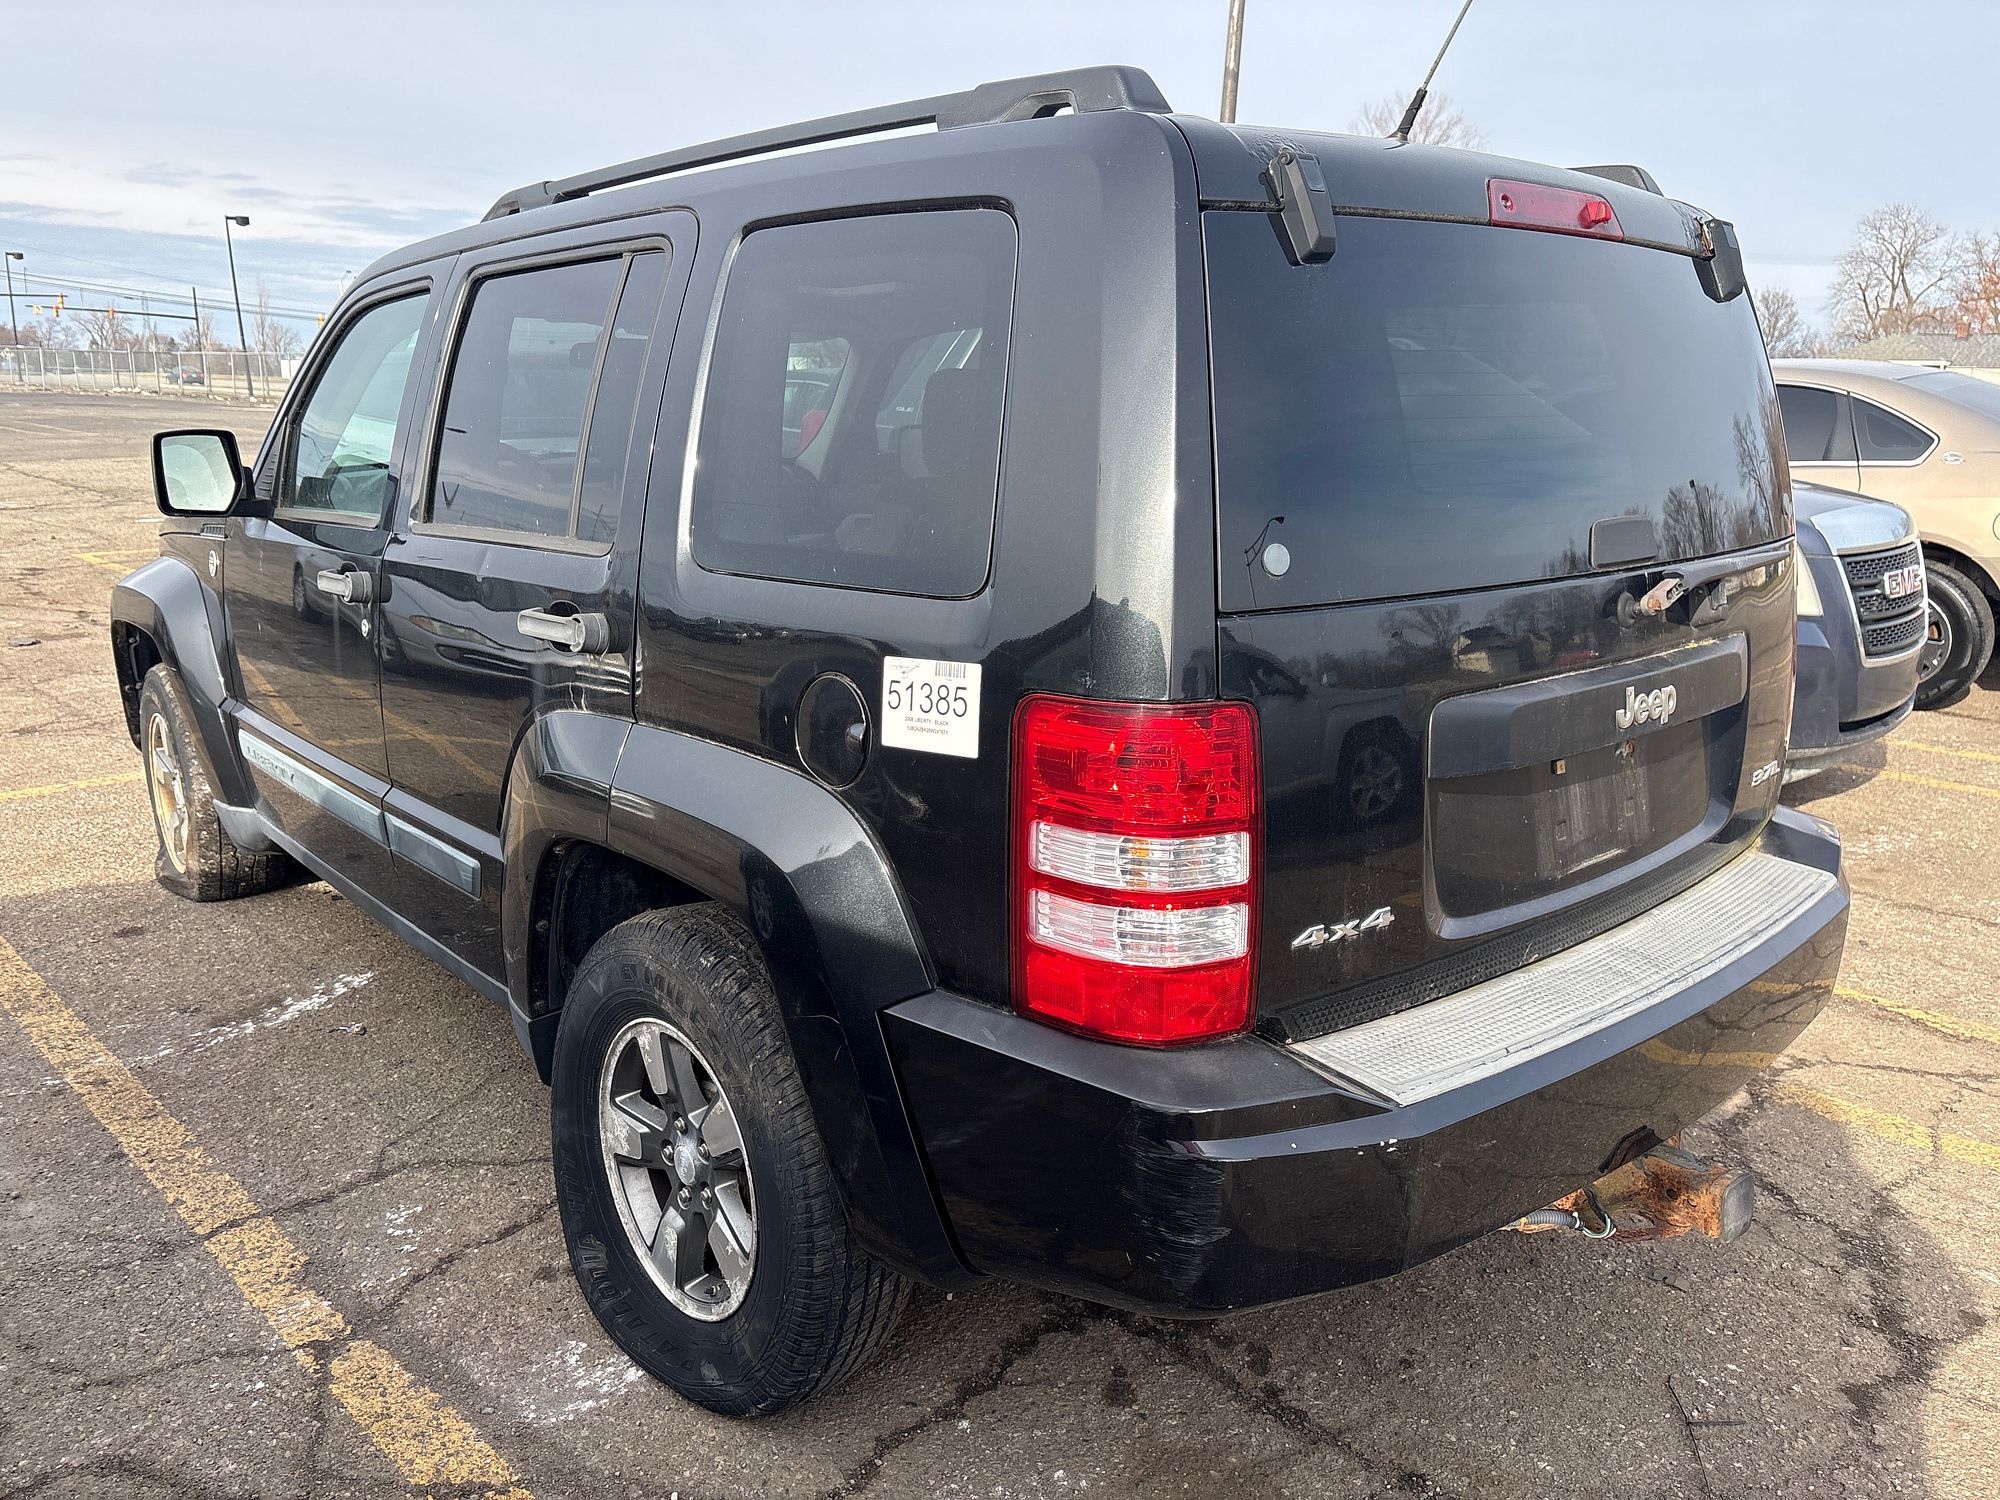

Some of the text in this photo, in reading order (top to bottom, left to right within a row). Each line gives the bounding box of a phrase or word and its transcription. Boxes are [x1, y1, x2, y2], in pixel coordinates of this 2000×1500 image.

[888, 680, 968, 717] 51385
[1616, 684, 1677, 729] Jeep
[914, 717, 932, 725] LIBERTY
[934, 719, 949, 727] BLACK
[246, 745, 295, 784] LIBERTY
